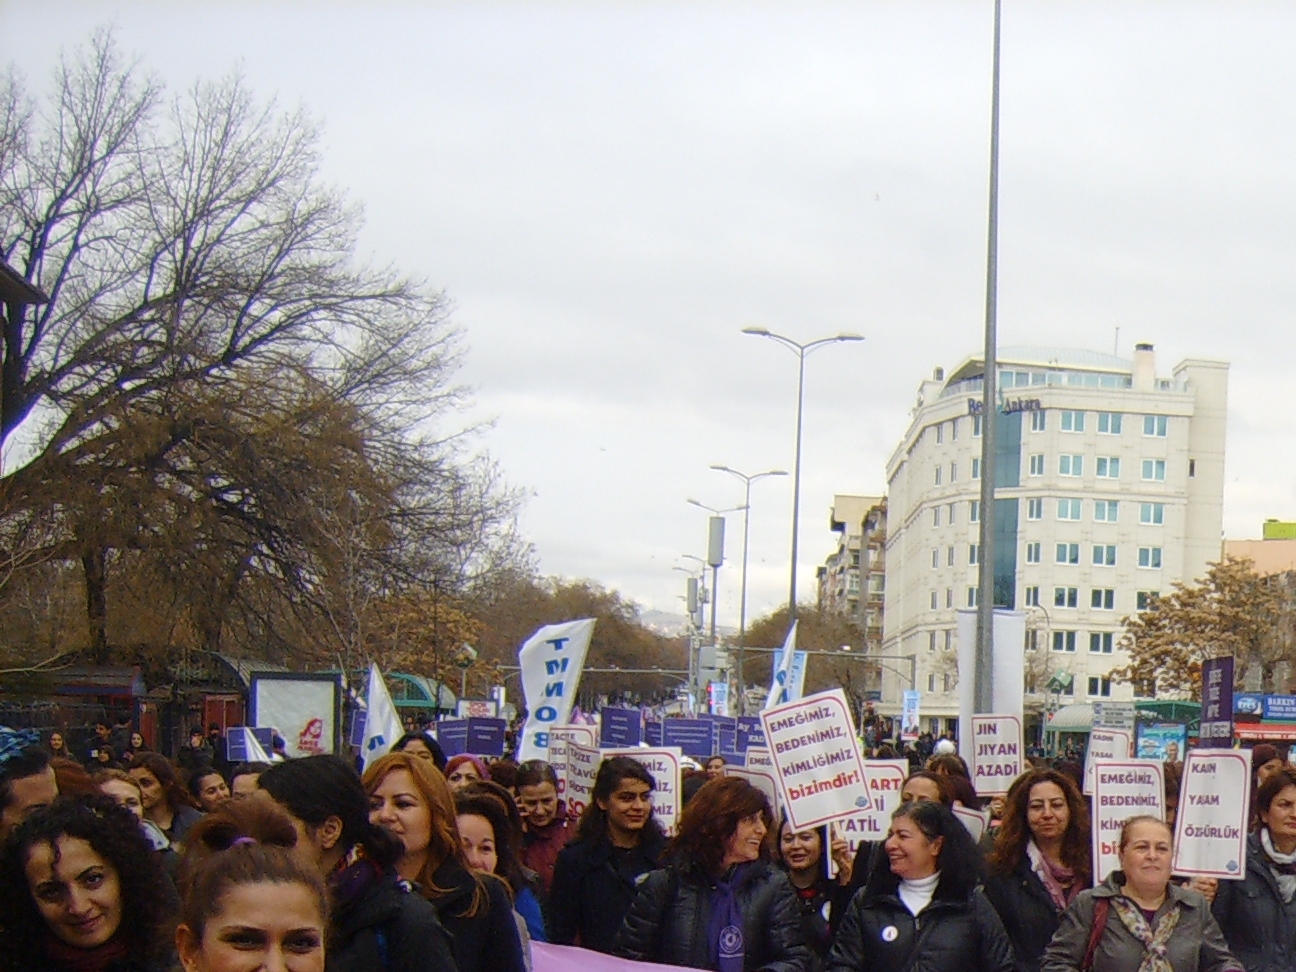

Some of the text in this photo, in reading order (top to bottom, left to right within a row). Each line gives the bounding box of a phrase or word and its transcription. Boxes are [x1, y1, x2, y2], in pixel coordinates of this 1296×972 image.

[769, 706, 836, 733] EMEĞİMİZ,
[975, 722, 997, 735] JIN
[776, 725, 847, 753] BEDENİMİZ,
[976, 742, 1017, 756] JIYAN
[782, 747, 855, 777] KİMLİĞİMİZ
[788, 771, 861, 800] bizimdir!
[870, 778, 901, 791] ART
